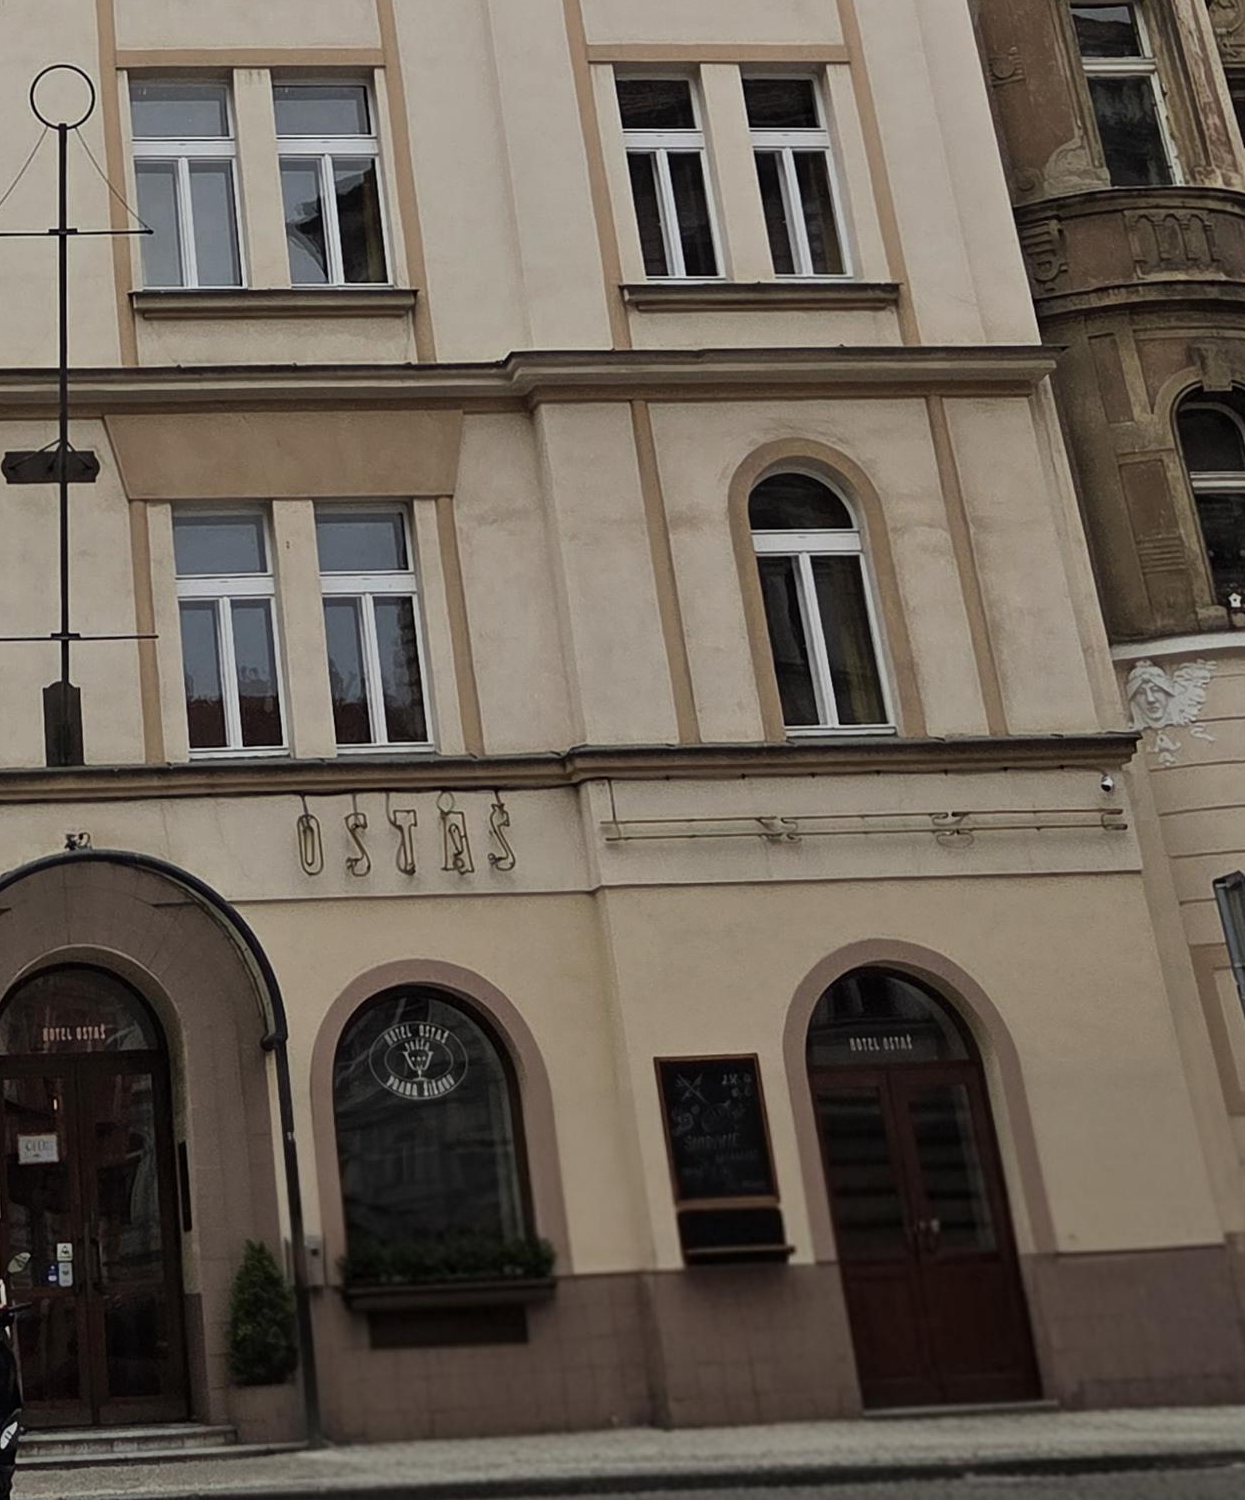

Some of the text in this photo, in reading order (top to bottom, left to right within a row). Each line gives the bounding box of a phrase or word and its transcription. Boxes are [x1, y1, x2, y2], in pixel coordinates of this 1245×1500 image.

[297, 803, 516, 877] OSTAŠ
[42, 1027, 72, 1041] HOTEL
[384, 1025, 412, 1046] HOTEL
[849, 1037, 880, 1051] HOTEL
